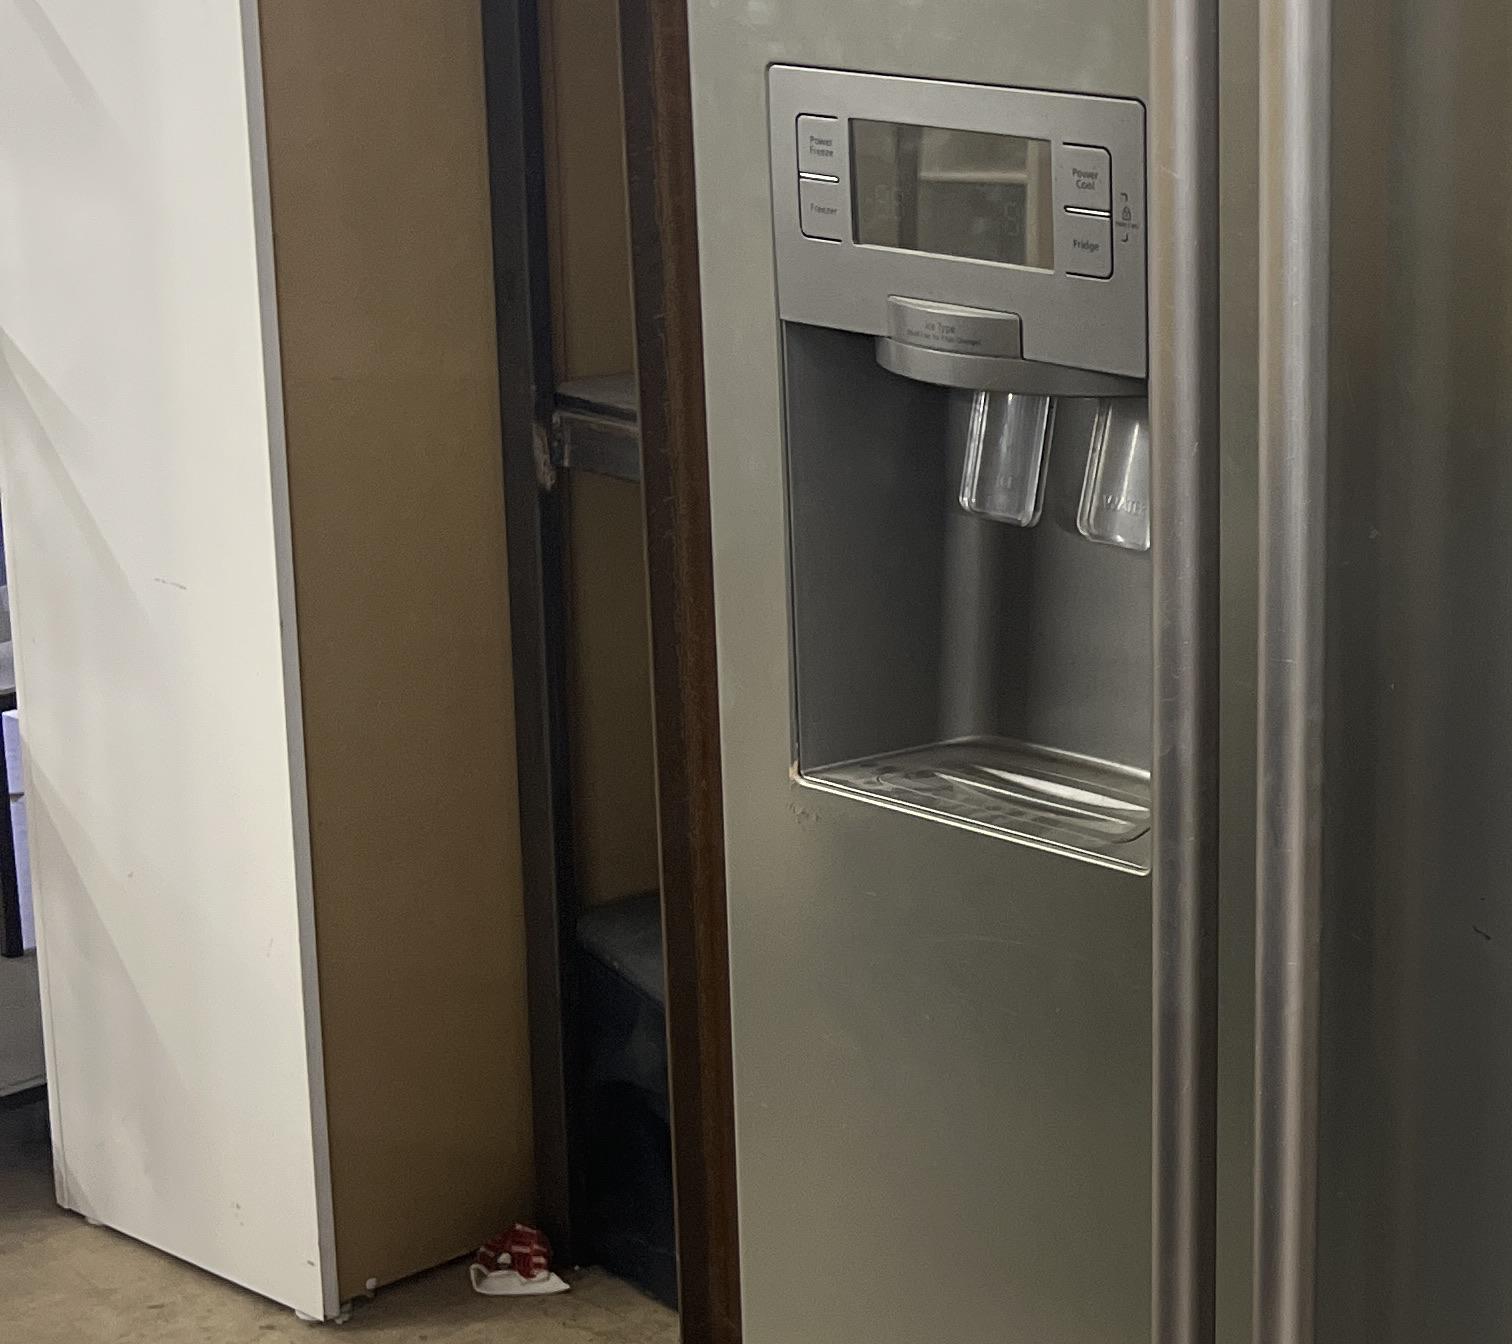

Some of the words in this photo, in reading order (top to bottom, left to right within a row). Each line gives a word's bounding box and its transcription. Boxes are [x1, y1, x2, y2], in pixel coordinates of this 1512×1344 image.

[1072, 167, 1099, 180] Power
[1075, 179, 1096, 191] Cool
[1073, 239, 1100, 253] Fridge
